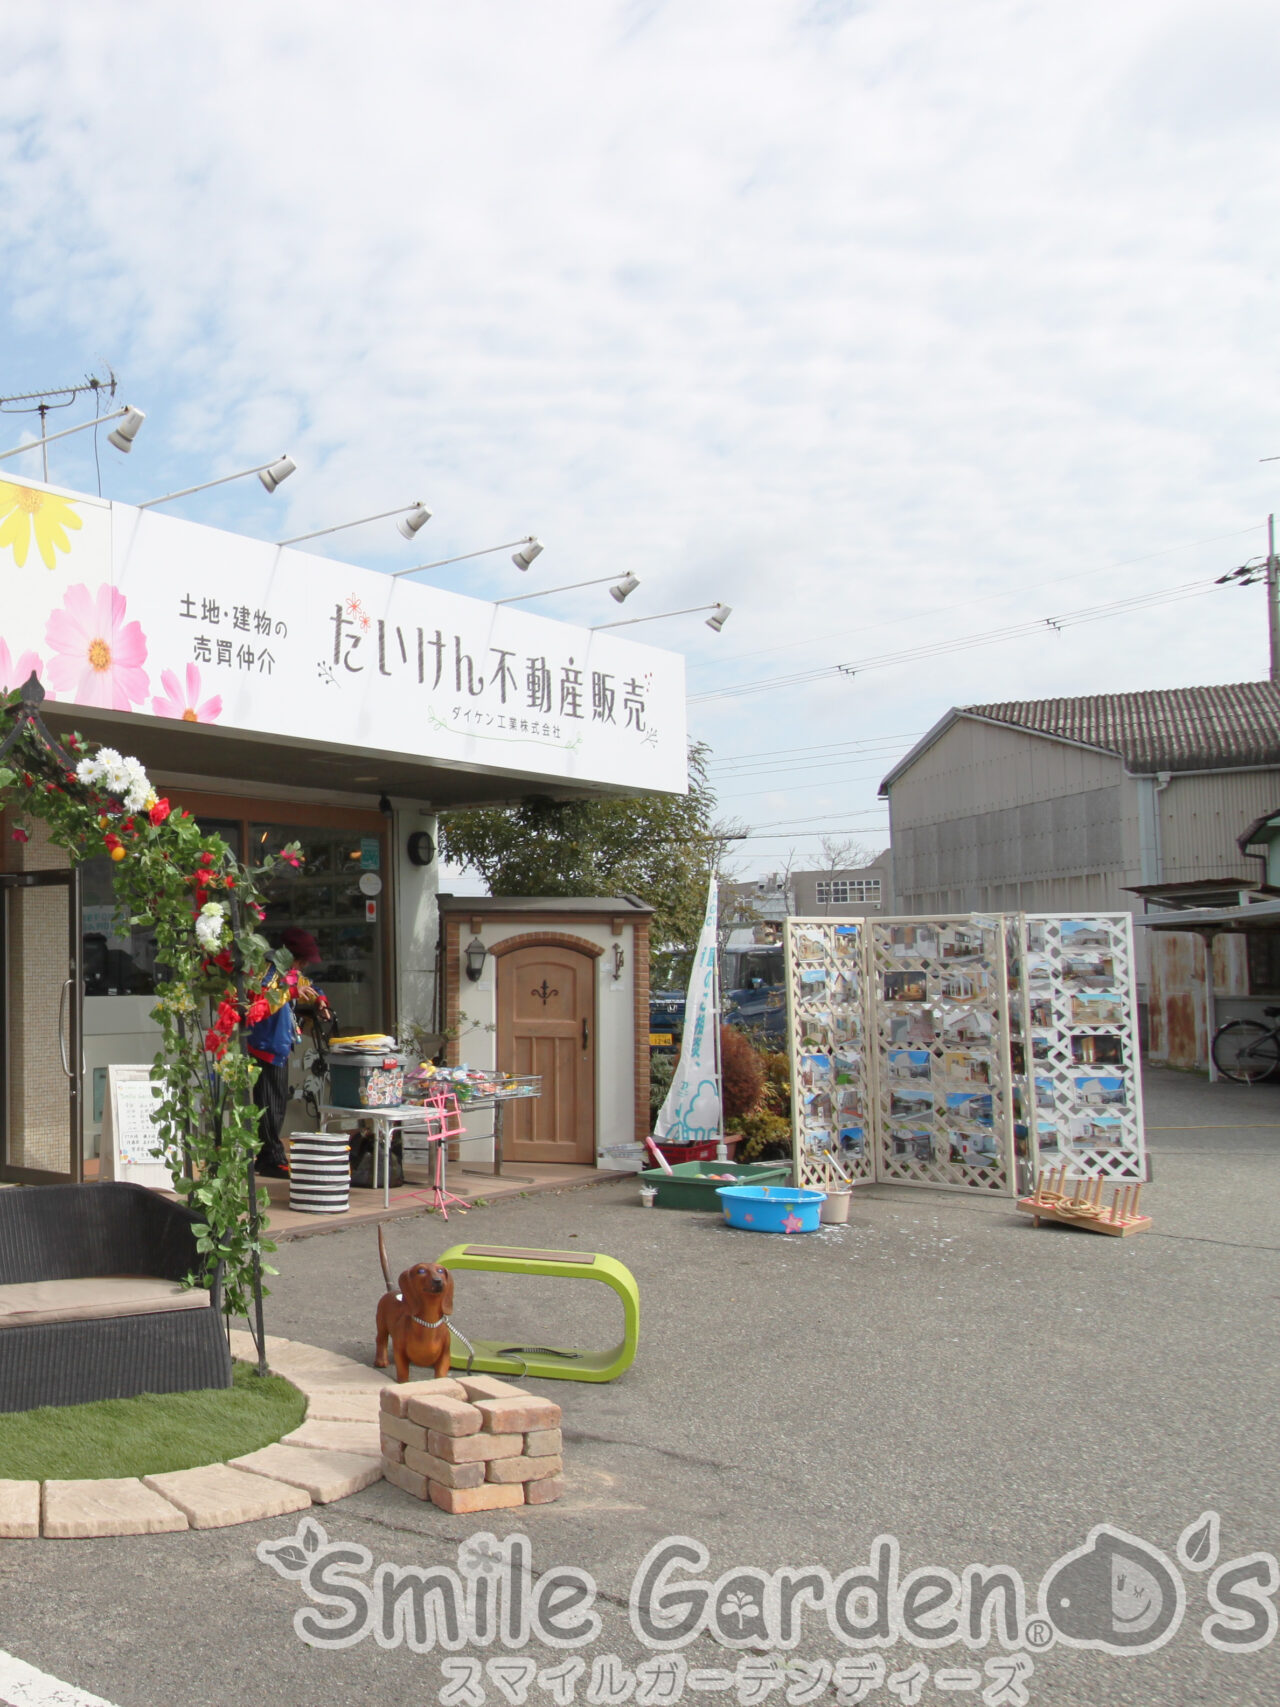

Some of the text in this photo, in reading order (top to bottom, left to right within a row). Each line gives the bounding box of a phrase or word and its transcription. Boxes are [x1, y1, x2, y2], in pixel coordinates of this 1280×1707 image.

[179, 592, 288, 640] 土地・建物の
[193, 635, 277, 676] 売買仲介
[451, 706, 562, 739] ダイケン工業株式会社
